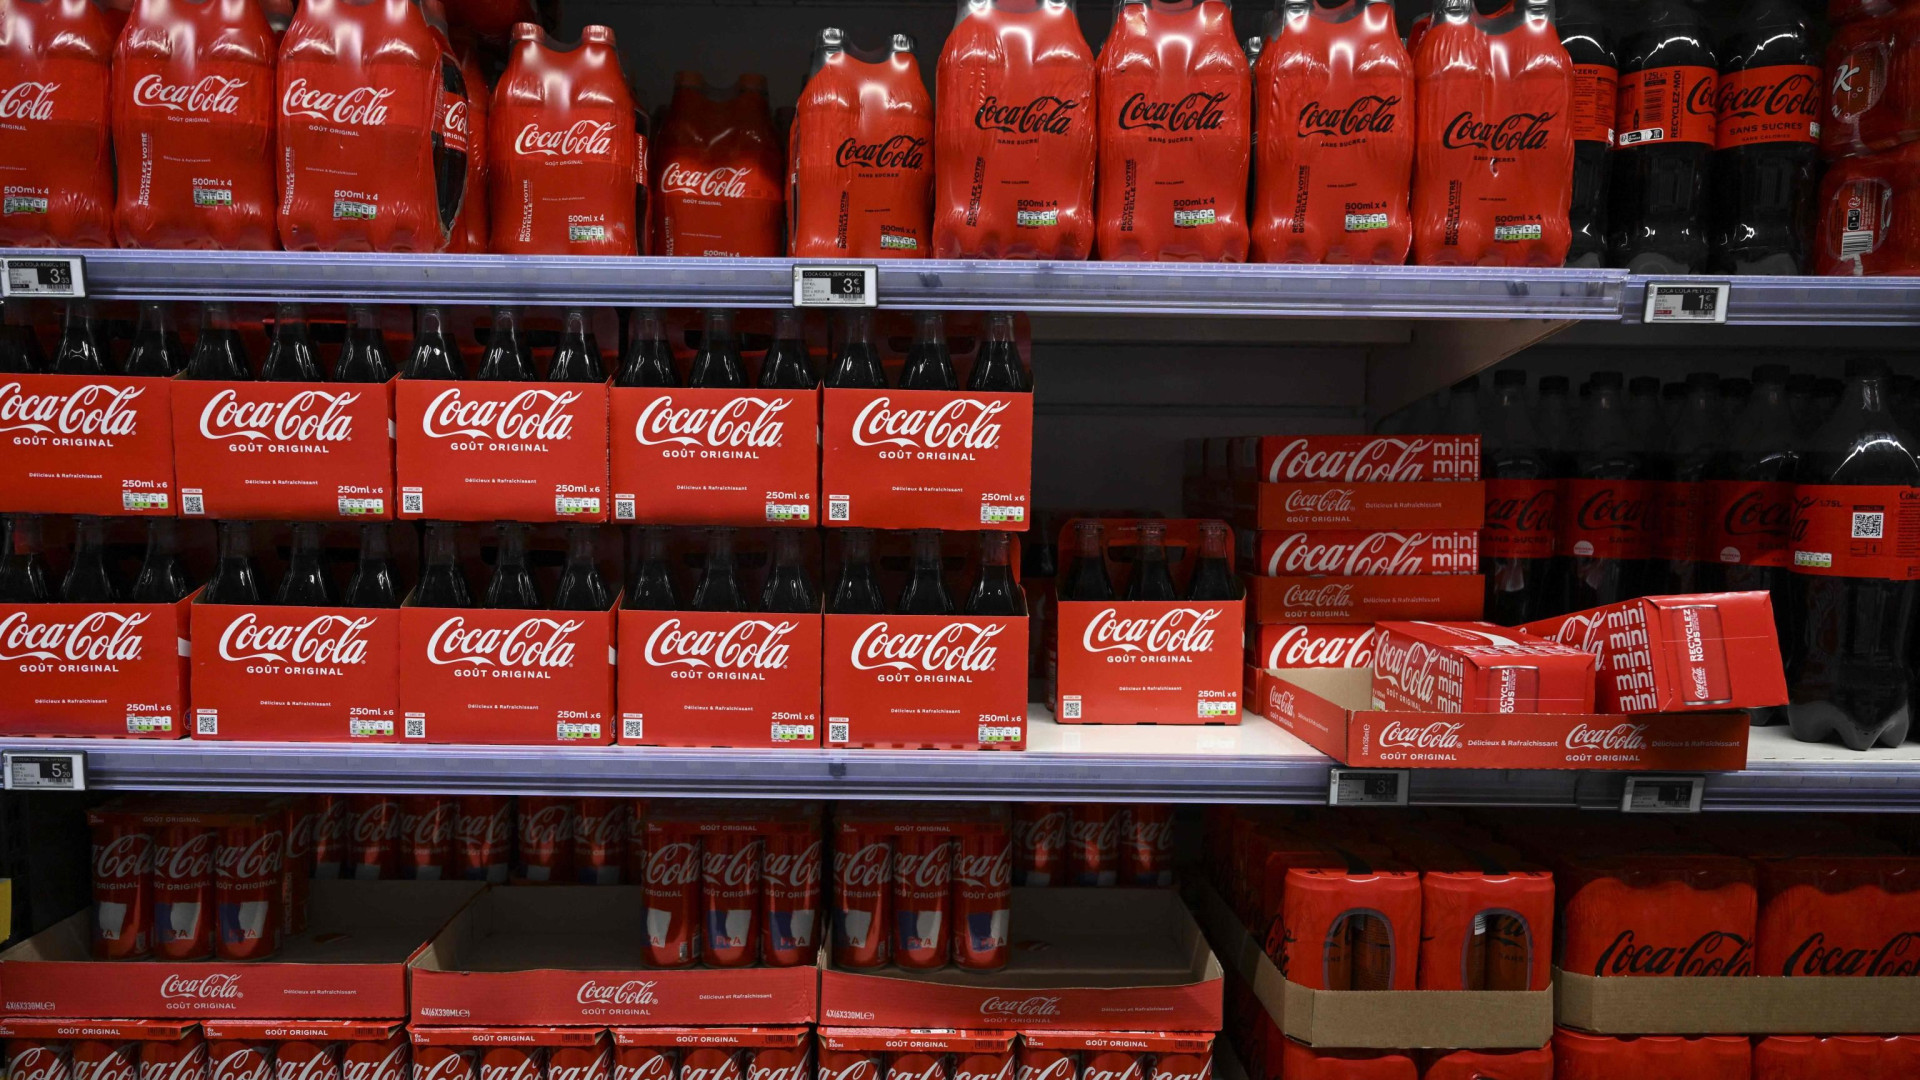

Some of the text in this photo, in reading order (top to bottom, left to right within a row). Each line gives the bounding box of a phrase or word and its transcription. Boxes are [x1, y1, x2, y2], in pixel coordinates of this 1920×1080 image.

[0, 82, 62, 120] -Cola
[133, 74, 248, 114] Coca-Cola
[282, 78, 396, 126] Coca-Cola
[1671, 70, 1680, 138] RECYCLEZ-MOI
[975, 96, 1079, 135] Coca-Cola
[1119, 92, 1230, 132] Coca-Cola
[1298, 95, 1402, 138] Coca-Cola
[308, 124, 359, 136] GOÛT ORIGINAL
[515, 120, 617, 156] Coca-Cola
[1442, 111, 1557, 151] Coca-Cola
[1730, 122, 1802, 136] SANS SUCRES
[836, 135, 929, 170] Coca-Cola
[4, 186, 34, 194] 500ml
[43, 186, 49, 194] 4
[192, 178, 218, 186] 500ml
[661, 162, 752, 198] Coca-Cola
[1017, 200, 1042, 208] 500ml
[1173, 199, 1201, 207] 500ml
[50, 268, 60, 283] 3
[843, 278, 853, 293] 3
[1699, 295, 1704, 309] 1
[200, 388, 362, 442] Coca-Cola
[422, 388, 583, 440] Coca-Cola
[635, 396, 793, 448] Coca-Cola
[852, 396, 1012, 449] Coca-Cola
[13, 436, 113, 447] GOÛT ORIGINAL
[229, 442, 329, 453] GOÛT ORIGINAL
[450, 440, 549, 452] GOÛT ORIGINAL
[1433, 438, 1479, 455] mini
[662, 448, 759, 459] GOÛT ORIGINAL
[879, 450, 976, 461] GOÛT ORIGINAL
[1269, 438, 1434, 483] Coca-Cola
[1433, 456, 1479, 473] mini
[122, 480, 153, 488] 250ml
[766, 491, 796, 500] 250ml
[1285, 489, 1356, 513] Coca-Cola
[1286, 515, 1309, 523] GOÛT
[1432, 532, 1478, 549] mini
[1268, 532, 1433, 576] Coca-Cola
[1432, 550, 1478, 566] mini
[1283, 584, 1355, 608] Coca-Cola
[1608, 602, 1645, 628] mini
[219, 612, 377, 664] Coca-Cola
[1083, 608, 1223, 653] Coca-Cola
[1610, 624, 1648, 649] mini
[1683, 609, 1697, 662] RECYCLEZ
[427, 616, 585, 668] Coca-Cola
[644, 618, 799, 669] Coca-Cola
[851, 621, 1007, 672] Coca-Cola
[1269, 625, 1375, 668] Coca-C
[1693, 631, 1704, 661] NOUS
[19, 663, 119, 673] GOÛT ORIGINAL
[1107, 654, 1192, 663] GOÛT ORIGINAL
[1374, 630, 1441, 704] Coca-Cola
[1440, 654, 1463, 677] mini
[1613, 645, 1650, 670] mini
[246, 665, 343, 676] GOÛT ORIGINAL
[454, 668, 551, 679] GOÛT ORIGINAL
[877, 672, 973, 683] GOÛT ORIGINAL
[1616, 667, 1653, 690] mini
[1438, 676, 1463, 697] mini
[350, 707, 381, 716] 250ml
[1620, 691, 1657, 712] mini
[1379, 721, 1465, 748] Coca-Cola
[1565, 723, 1649, 750] Coca-Cola
[1380, 752, 1407, 760] GOÛT
[1565, 753, 1592, 762] GOÛT
[52, 764, 61, 777] 5
[161, 973, 239, 999] Coca-Cola
[576, 980, 654, 1005] Coca-Cola
[166, 1001, 191, 1010] GOÛT
[582, 1007, 606, 1016] GOÛT
[980, 996, 1057, 1015] Coca-Cola
[58, 1027, 120, 1036] GOÛT ORIGINAL
[265, 1028, 286, 1036] GOÛT
